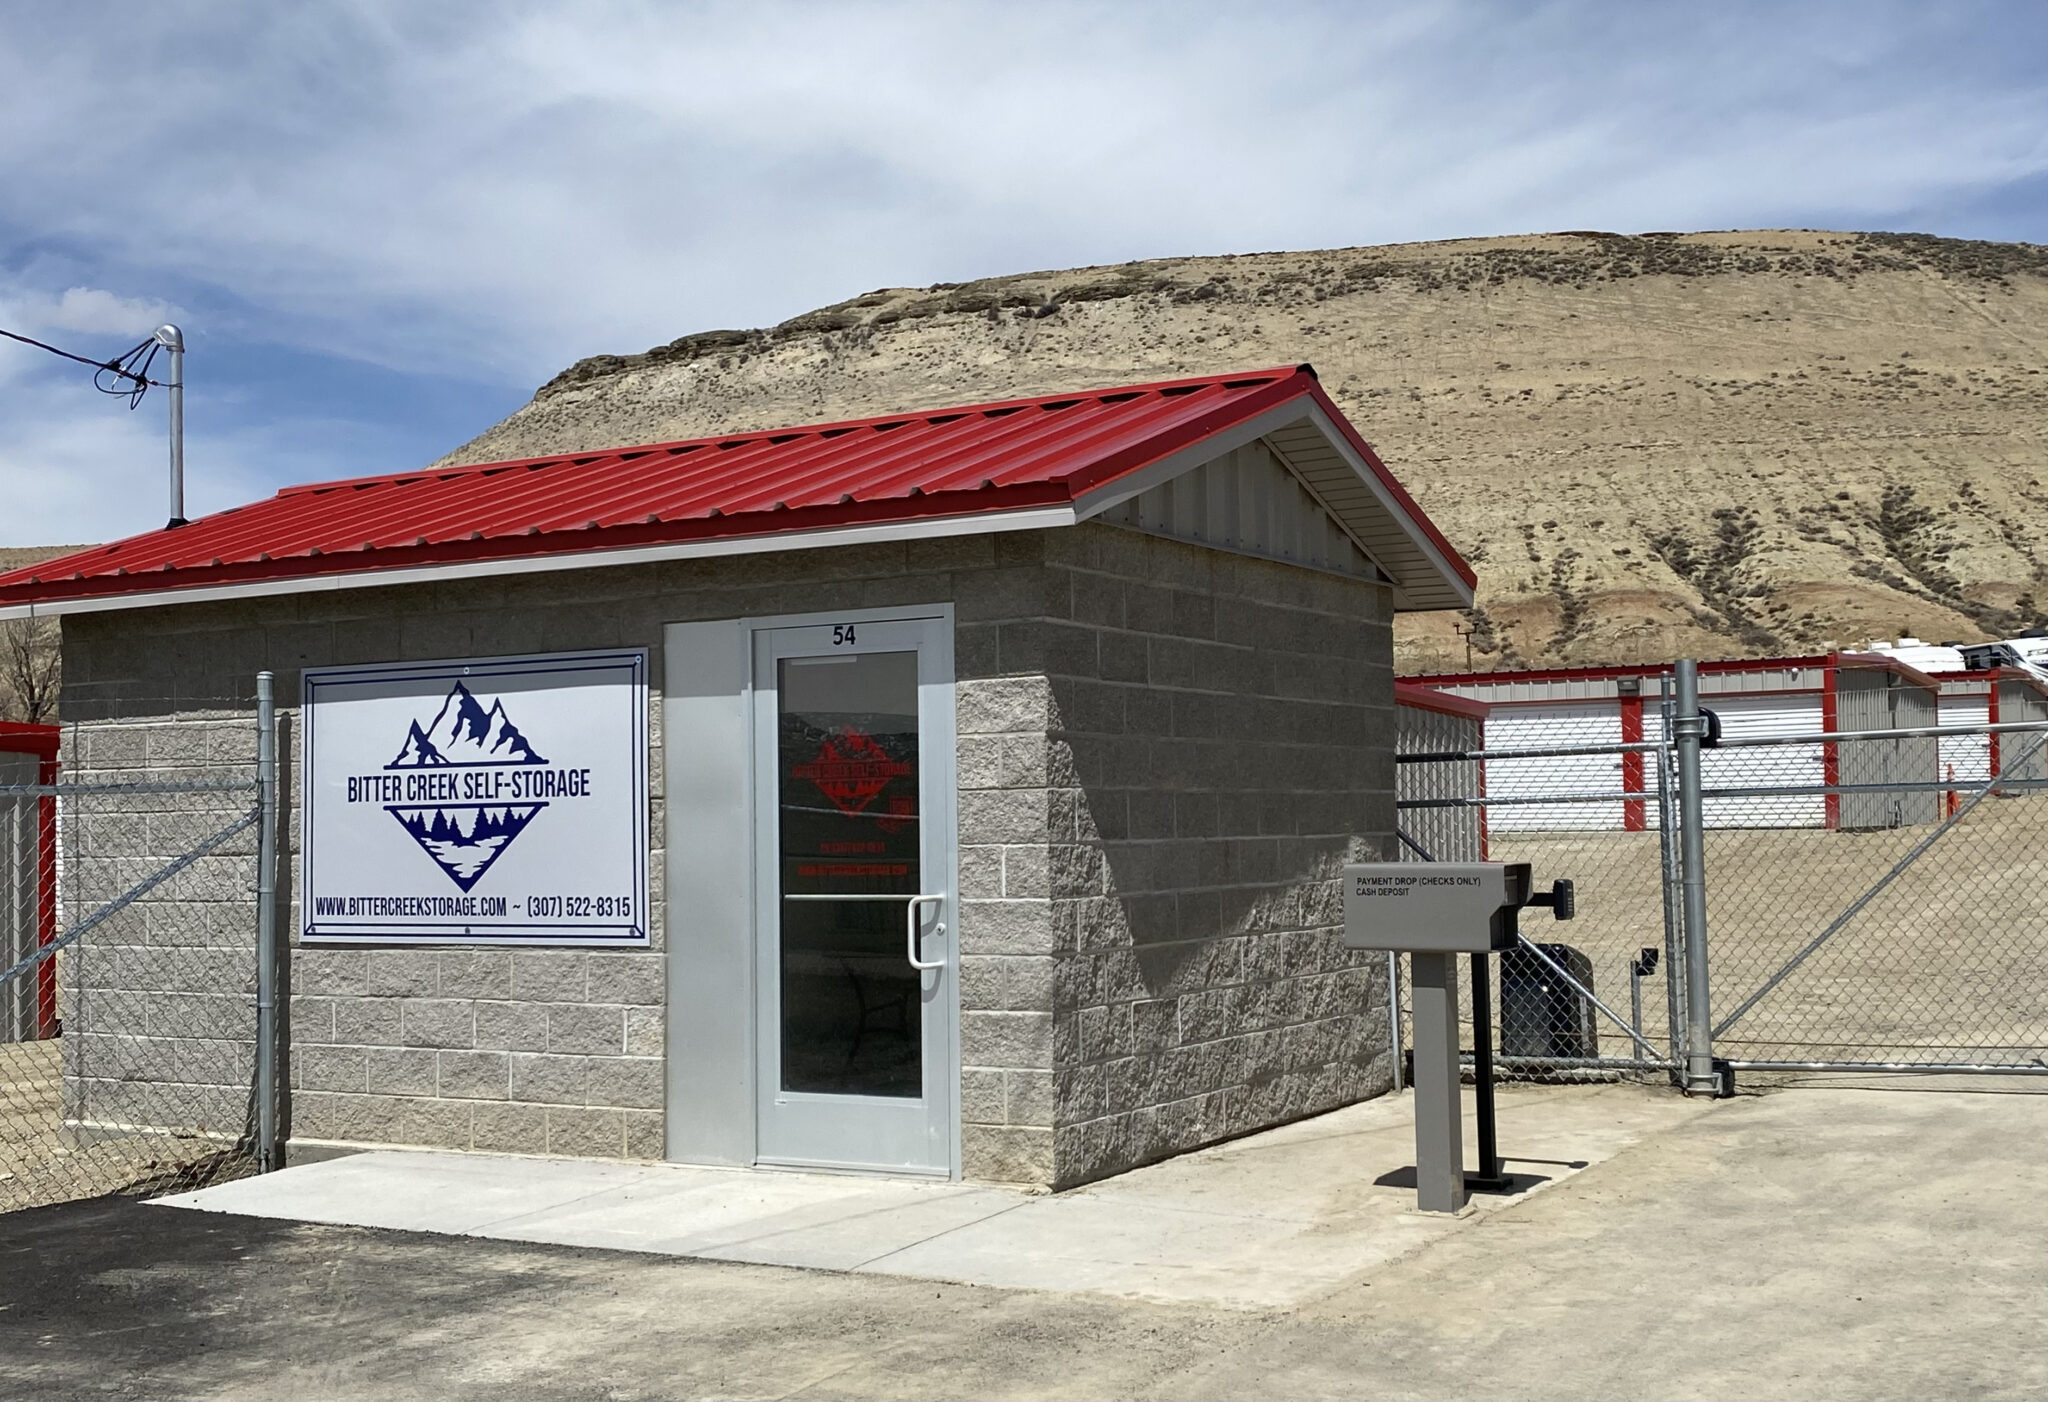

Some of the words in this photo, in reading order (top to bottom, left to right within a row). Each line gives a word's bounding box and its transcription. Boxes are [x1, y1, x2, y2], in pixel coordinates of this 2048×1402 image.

[833, 625, 856, 645] 54
[348, 774, 401, 802] BITTER
[406, 773, 458, 801] CREEK
[463, 768, 591, 799] SELF-STORAGE
[1356, 888, 1376, 896] CASH
[1378, 887, 1409, 896] DEPOSIT
[1357, 877, 1392, 885] PAYMENT
[1394, 877, 1417, 885] DROP
[1419, 877, 1454, 886] (CHECKS
[1456, 877, 1481, 886] ONLY)
[315, 896, 507, 917] WWW.BITTERCREEKSTORAGE.COM
[527, 896, 563, 918] (307)
[566, 896, 631, 917] 522-8315
